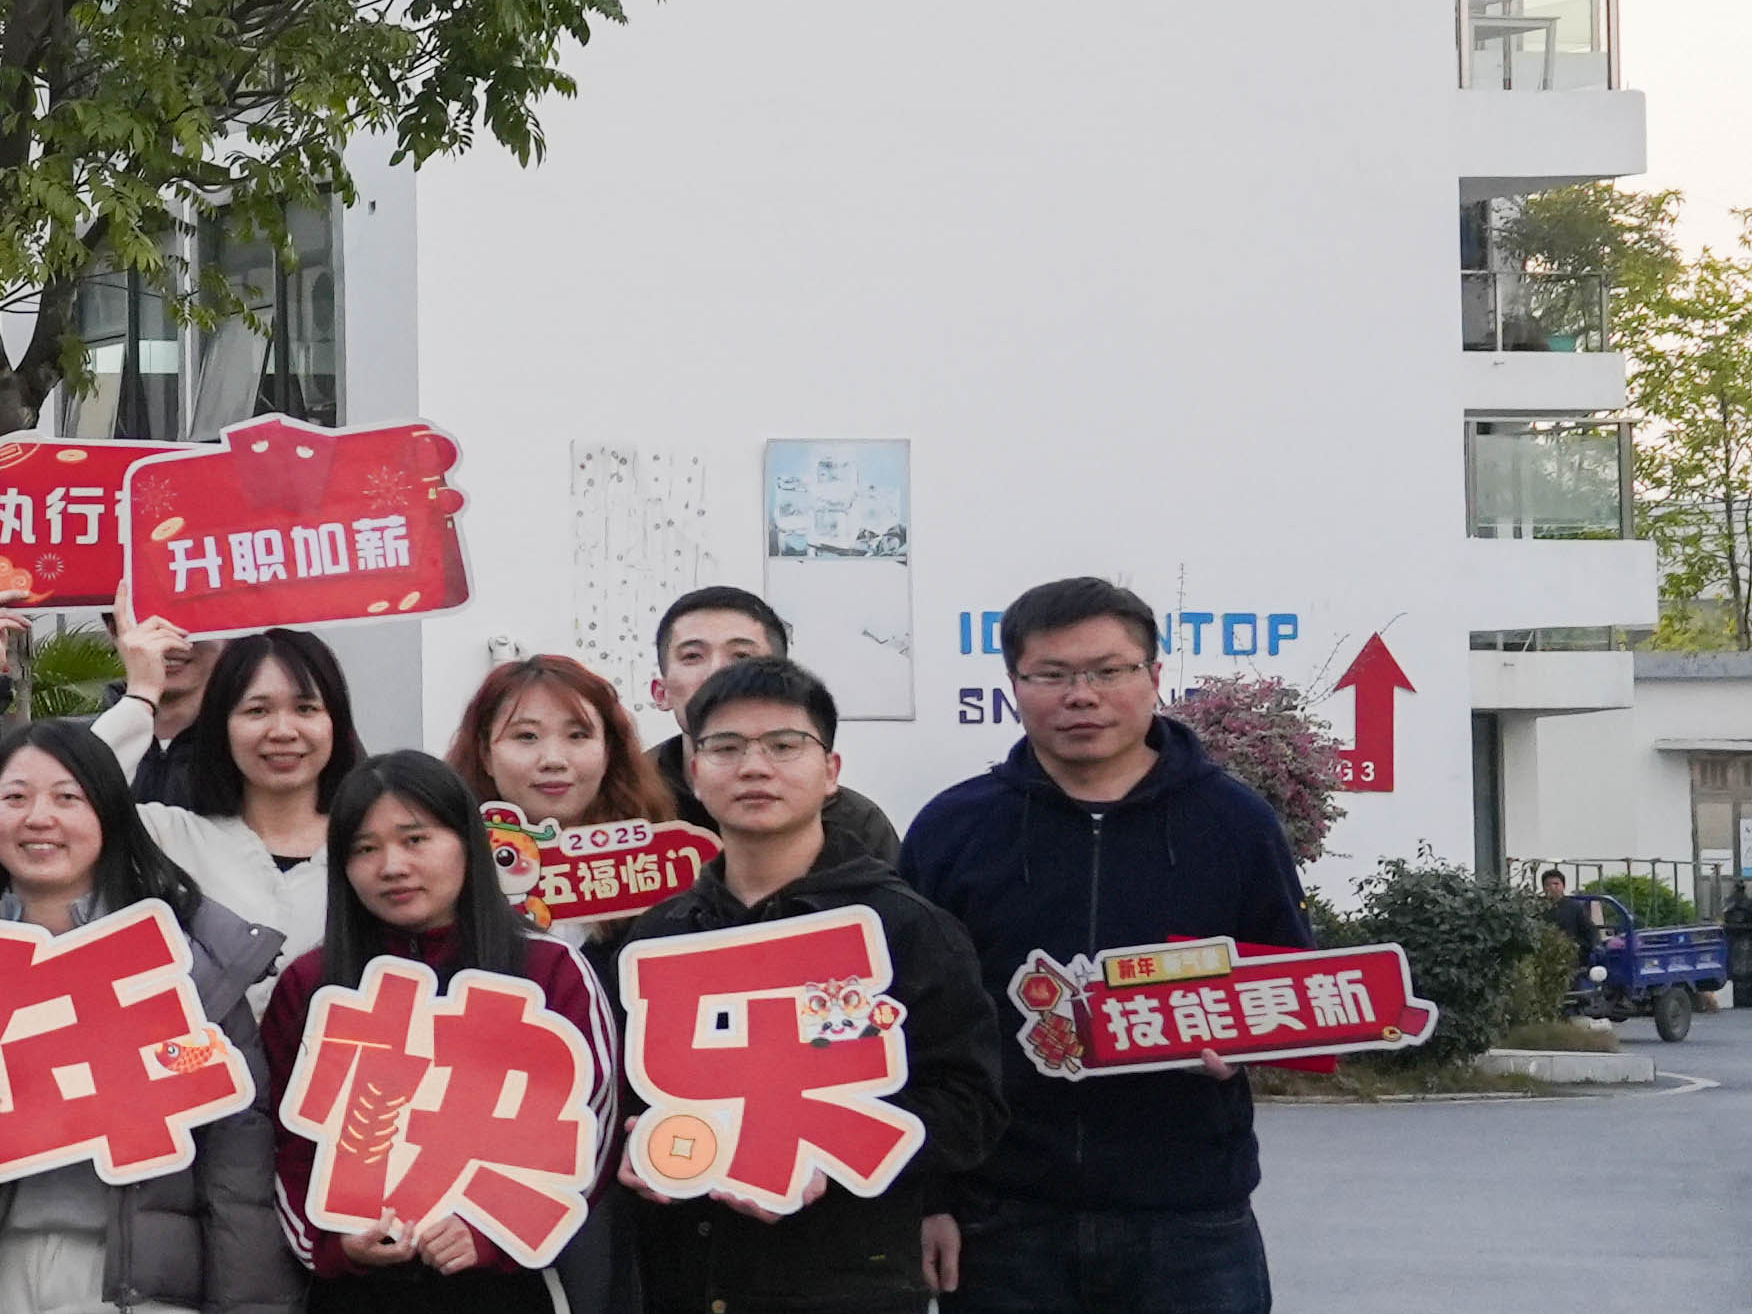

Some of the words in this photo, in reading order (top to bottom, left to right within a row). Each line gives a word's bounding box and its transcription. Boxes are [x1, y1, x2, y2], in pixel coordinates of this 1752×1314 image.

[167, 513, 412, 593] 升职加薪
[1360, 760, 1376, 782] 3
[538, 846, 703, 904] 五福临门
[1101, 969, 1376, 1051] 技能更新
[635, 926, 912, 1198] 乐
[296, 972, 581, 1253] 快
